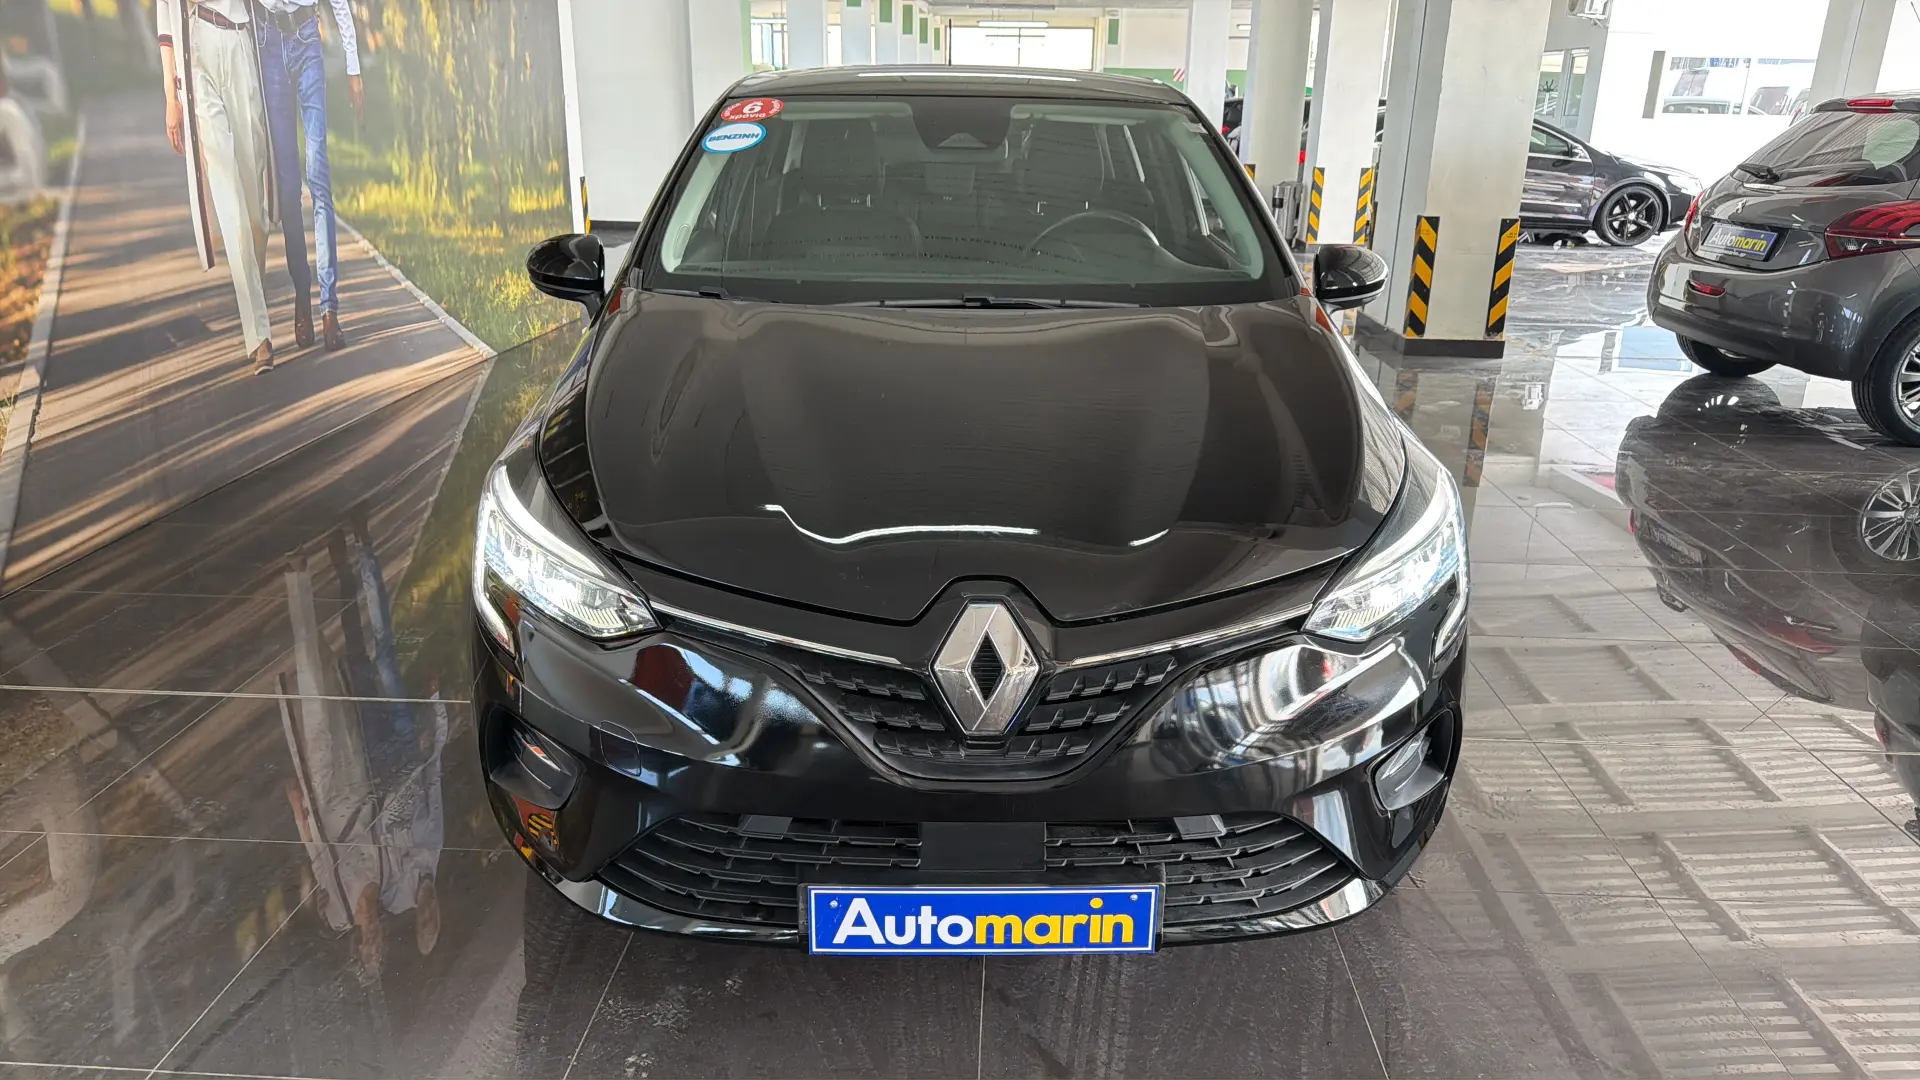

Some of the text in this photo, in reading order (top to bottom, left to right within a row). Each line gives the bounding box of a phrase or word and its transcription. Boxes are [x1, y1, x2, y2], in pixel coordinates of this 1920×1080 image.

[742, 101, 764, 114] 6
[1710, 227, 1767, 251] Automarin
[832, 897, 1134, 945] Automarin
